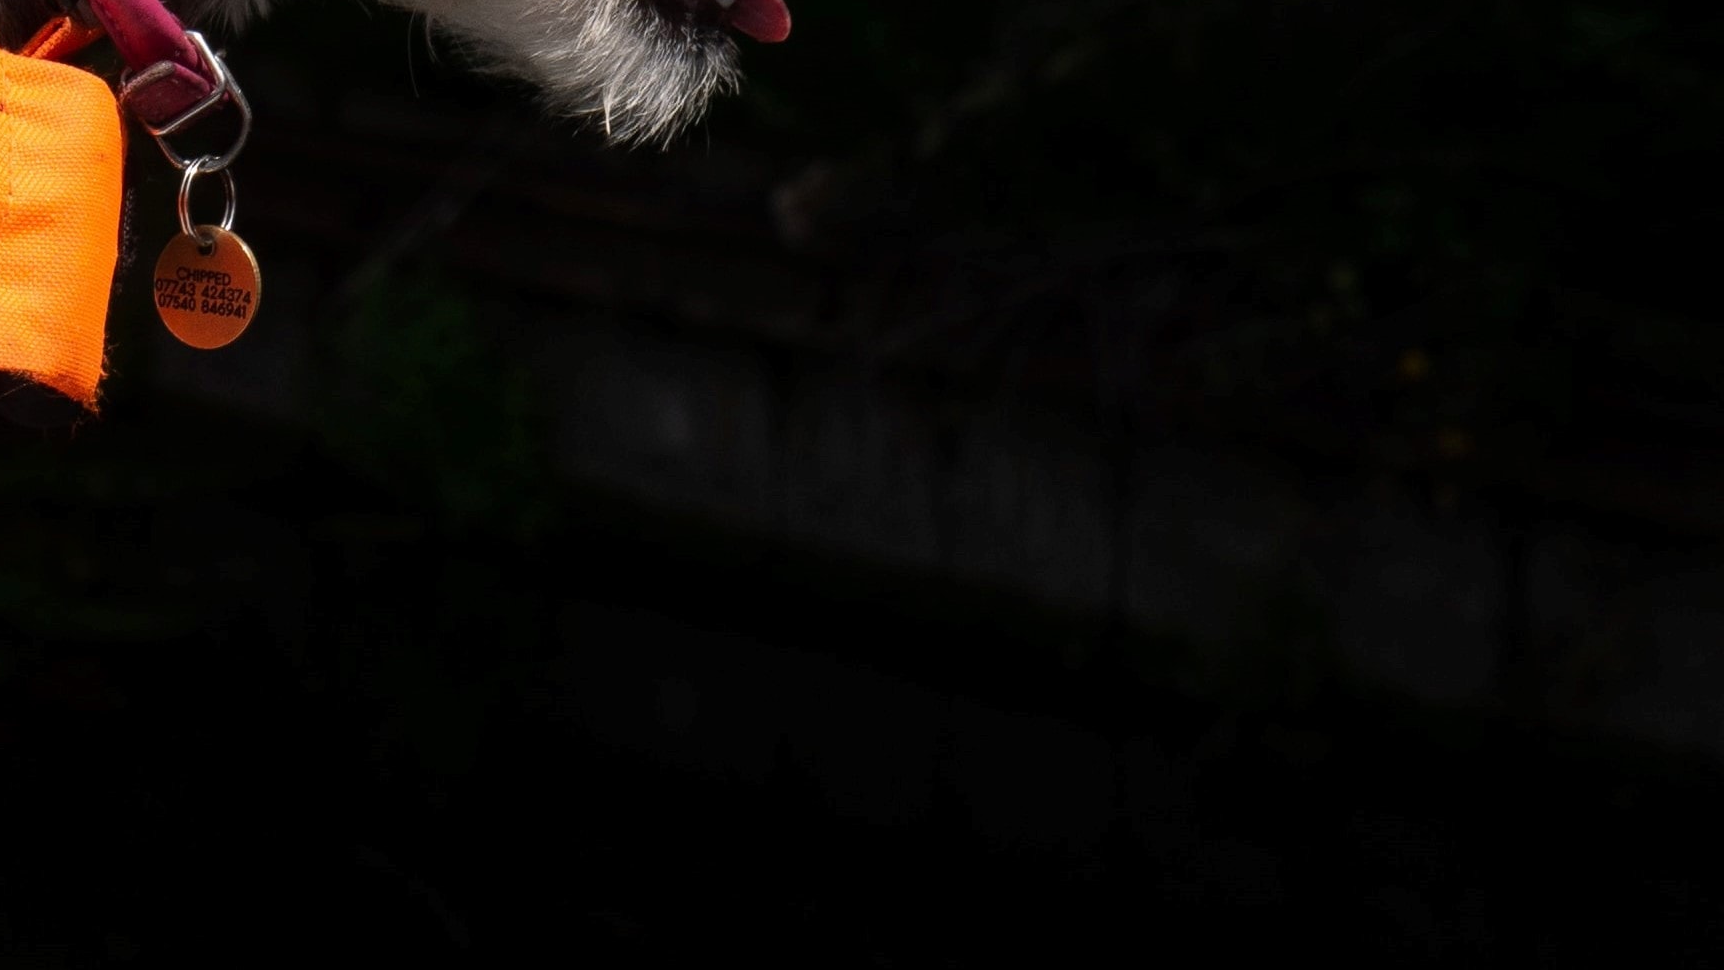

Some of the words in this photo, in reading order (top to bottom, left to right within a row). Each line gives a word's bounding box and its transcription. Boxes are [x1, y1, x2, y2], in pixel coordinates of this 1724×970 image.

[176, 266, 231, 285] CHIPPED
[156, 278, 195, 296] 07743
[201, 284, 251, 304] 424374
[158, 293, 196, 311] 07540
[201, 300, 246, 318] 846941
